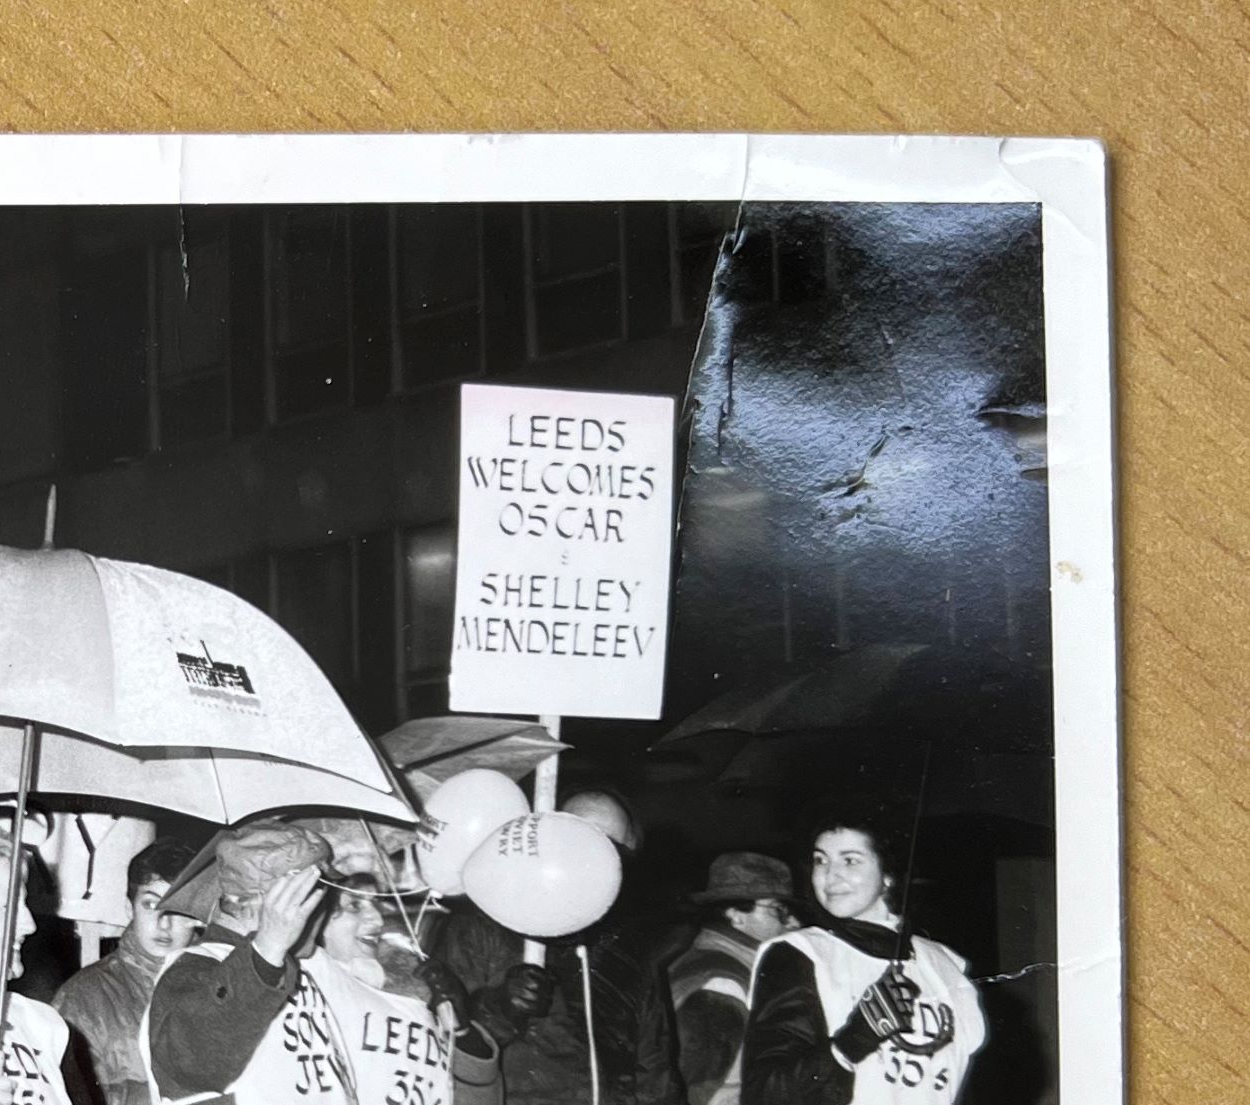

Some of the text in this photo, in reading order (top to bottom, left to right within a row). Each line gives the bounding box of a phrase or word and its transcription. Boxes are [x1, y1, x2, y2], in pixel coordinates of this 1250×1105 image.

[508, 415, 627, 452] LEEDS
[467, 456, 656, 500] WELCOMES
[499, 502, 624, 543] OSCAR
[480, 573, 640, 612] SHELLEY
[457, 616, 656, 658] MENDELEEV
[283, 1011, 330, 1051] SOV
